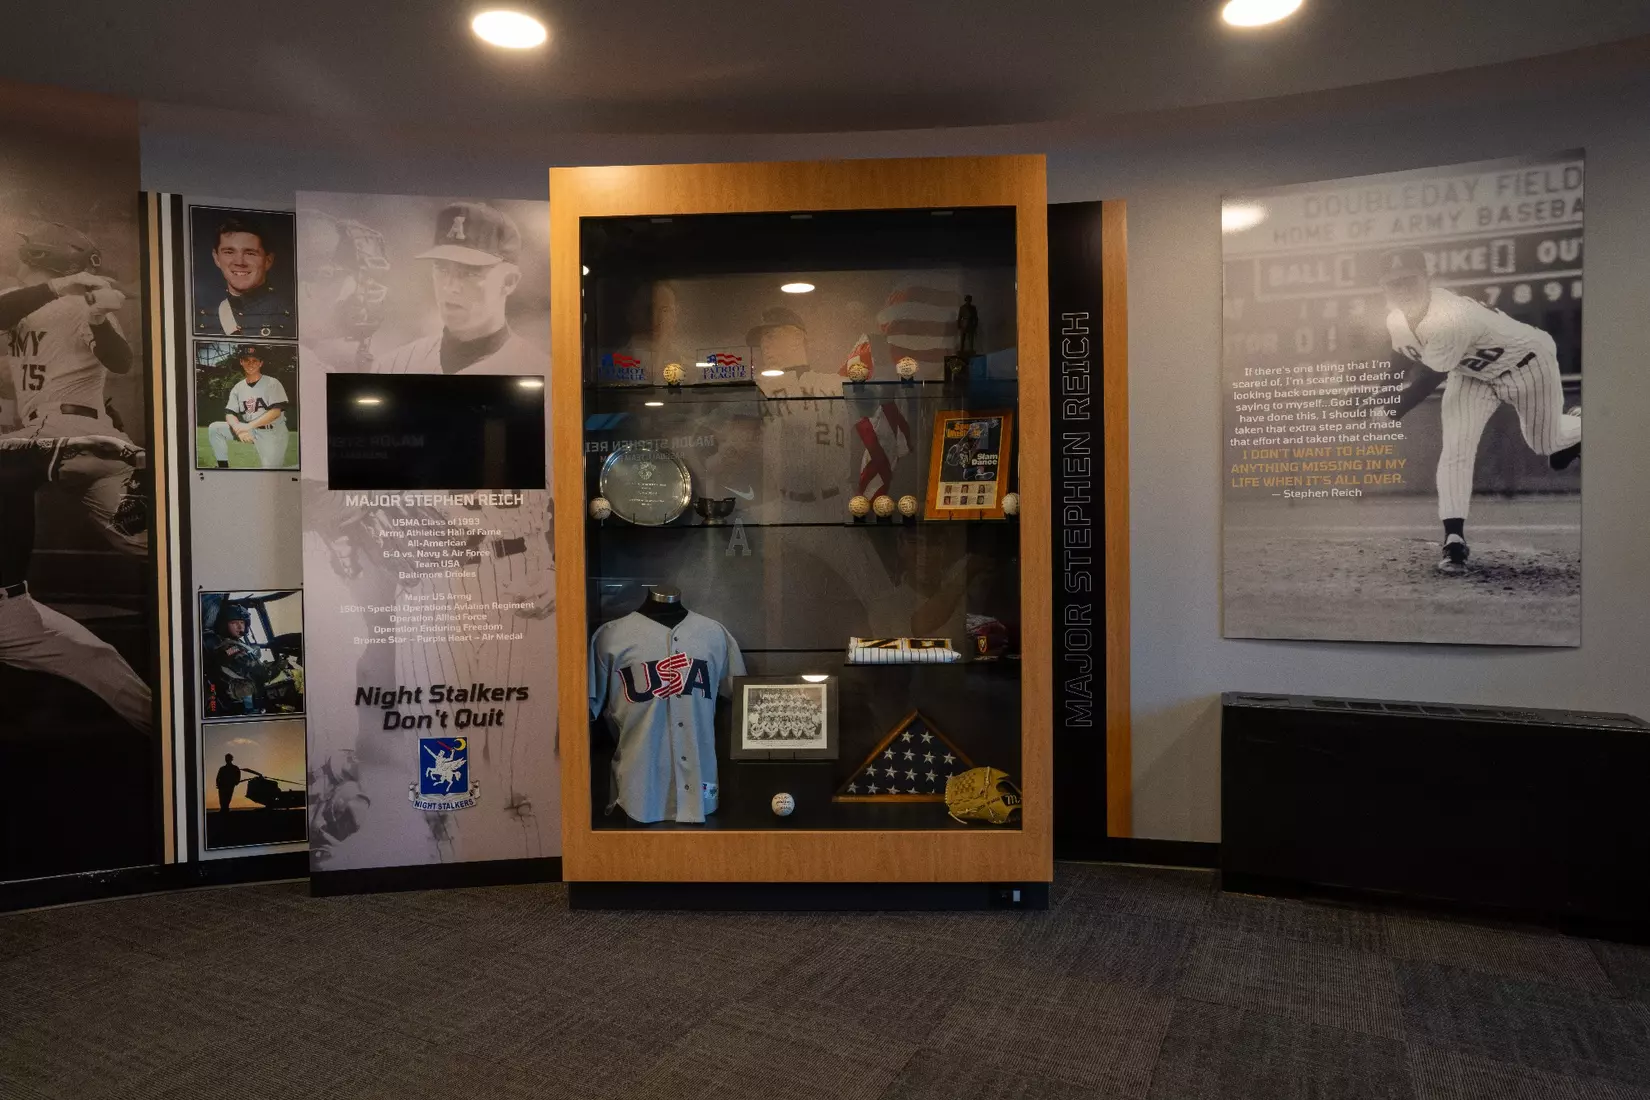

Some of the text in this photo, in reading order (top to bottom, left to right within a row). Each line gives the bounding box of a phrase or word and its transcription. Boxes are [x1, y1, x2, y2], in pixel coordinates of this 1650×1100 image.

[1304, 165, 1582, 218] DOUBLEDAY FIELD
[446, 216, 466, 239] A
[1273, 224, 1335, 244] HOME
[1351, 221, 1373, 239] OF
[1390, 211, 1463, 235] ARMY
[1268, 260, 1331, 287] BALL
[1484, 285, 1502, 306] 7
[1512, 283, 1533, 304] 8
[1544, 281, 1563, 301] 9
[1460, 347, 1505, 372] 20
[703, 365, 746, 375] PATRIOT
[703, 371, 746, 380] LEAGUE
[1244, 367, 1253, 376] If
[1254, 366, 1291, 376] there's
[1316, 363, 1345, 374] thing
[1347, 361, 1369, 372] that
[1372, 360, 1391, 369] I'm
[22, 364, 46, 391] 15
[1232, 379, 1268, 388] scared
[1286, 376, 1304, 386] I'm
[1306, 375, 1343, 385] scared
[1345, 373, 1356, 382] to
[1359, 371, 1391, 382] death
[1393, 370, 1405, 380] of
[1233, 382, 1404, 401] looking back on everything and
[1235, 402, 1270, 413] saying
[1272, 401, 1283, 410] to
[1355, 397, 1360, 406] I
[1362, 395, 1401, 405] should
[1239, 413, 1265, 423] have
[1267, 412, 1294, 422] done
[1322, 411, 1327, 419] I
[1328, 409, 1367, 419] should
[1369, 408, 1397, 417] have
[816, 421, 845, 448] 20
[1234, 419, 1402, 435] taken that extra step and made
[1230, 432, 1407, 447] that effort and taken that chance.
[1243, 444, 1393, 460] I DON'T WANT TO HAVE
[1230, 458, 1407, 474] ANYTHING MISSING IN MY
[1232, 473, 1406, 488] LIFE WHEN IT'S ALL OVER.
[345, 493, 524, 507] MAJOR STEPHEN REICH
[1284, 489, 1329, 499] Stephen
[1331, 488, 1363, 497] Reich
[392, 517, 480, 527] USMA Class of 1993
[1060, 310, 1094, 728] MAJOR STEPHEN REICH
[379, 527, 502, 539] Army Athletics Hall of Fame
[725, 516, 752, 556] A
[407, 538, 467, 547] All-American
[416, 549, 441, 559] Navy
[442, 549, 450, 557] &
[450, 548, 464, 557] Air
[466, 549, 490, 557] Force
[415, 560, 460, 568] Team USA
[398, 570, 477, 579] Baltimore Orioles
[405, 592, 472, 603] Major US Army
[367, 604, 401, 614] Special
[402, 603, 452, 613] Operations
[454, 602, 490, 611] Aviation
[491, 601, 535, 611] Regiment
[389, 612, 488, 623] Operation Allied Force
[373, 623, 503, 634] Operation Enduring Freedom
[353, 636, 387, 645] Bronze
[388, 635, 407, 644] Star
[416, 635, 446, 644] Purple
[447, 634, 472, 642] Heart
[482, 633, 495, 641] Air
[496, 632, 524, 641] Medal
[615, 652, 713, 704] USA
[355, 683, 529, 710] Night Stalkers
[383, 708, 504, 730] Don't Quit
[414, 798, 474, 810] NIGHT STALKERS
